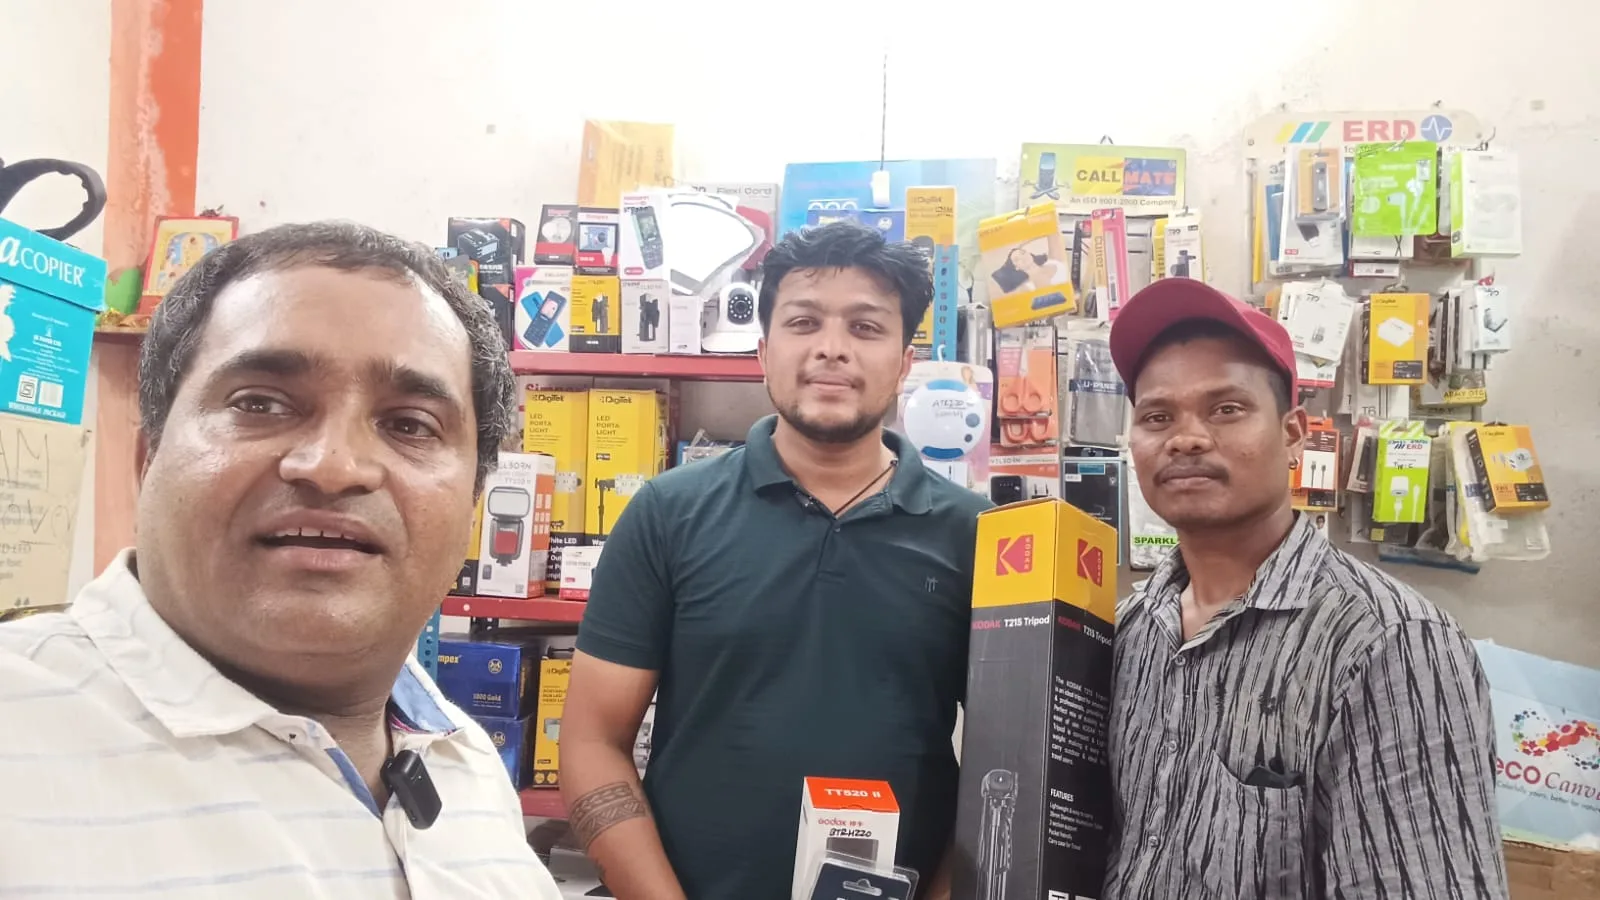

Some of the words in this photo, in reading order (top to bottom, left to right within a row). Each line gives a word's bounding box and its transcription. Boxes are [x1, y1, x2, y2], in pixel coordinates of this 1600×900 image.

[1343, 120, 1416, 141] ERD
[1076, 169, 1121, 183] CALL
[1124, 171, 1176, 185] MATE
[744, 187, 772, 195] Cord
[1362, 406, 1377, 417] T6
[1134, 536, 1176, 545] SPARKL
[972, 621, 1001, 630] KODAK
[1004, 618, 1023, 628] T215
[1024, 615, 1050, 626] Tripod
[1058, 616, 1081, 631] KODAK
[1083, 625, 1095, 638] T215
[1095, 629, 1112, 646] Tripod
[438, 655, 459, 664] mpex
[1056, 675, 1064, 684] The
[1066, 680, 1082, 691] KODAK
[1053, 722, 1066, 733] Tripod
[1051, 743, 1062, 753] carry
[1496, 757, 1542, 785] eco
[824, 788, 869, 798] TT520
[1051, 788, 1074, 802] FEATURES
